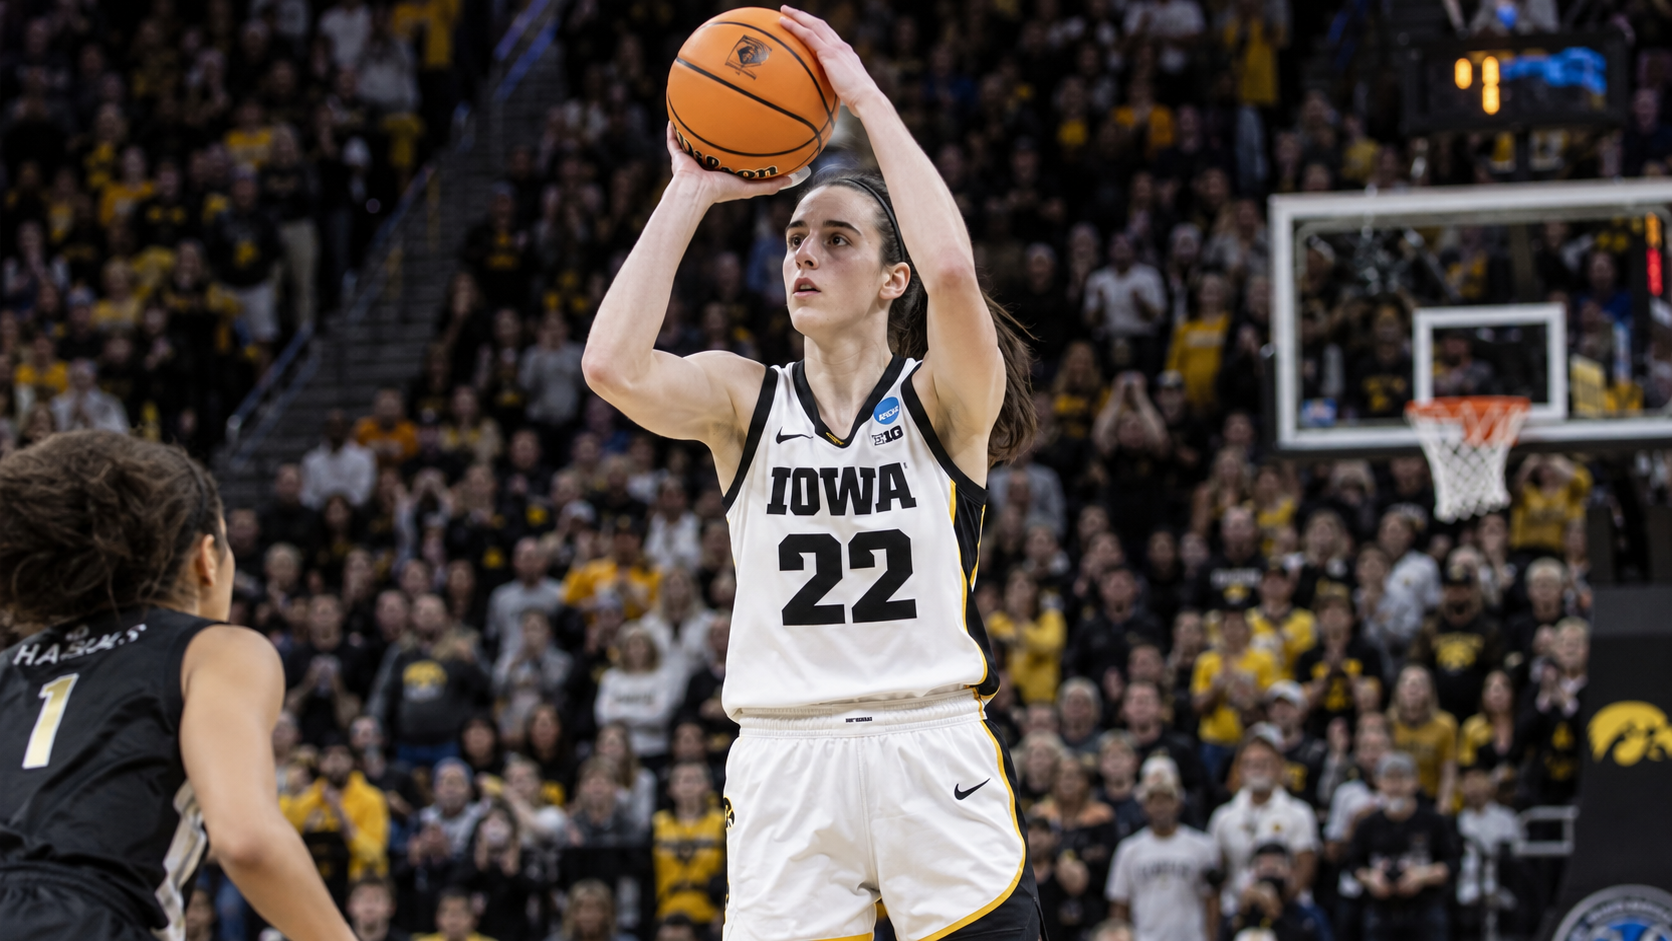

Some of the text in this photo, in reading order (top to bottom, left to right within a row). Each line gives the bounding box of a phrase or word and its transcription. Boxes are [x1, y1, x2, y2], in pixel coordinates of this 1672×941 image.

[766, 462, 917, 516] IOWA
[778, 528, 917, 627] 22
[21, 672, 80, 770] 1
